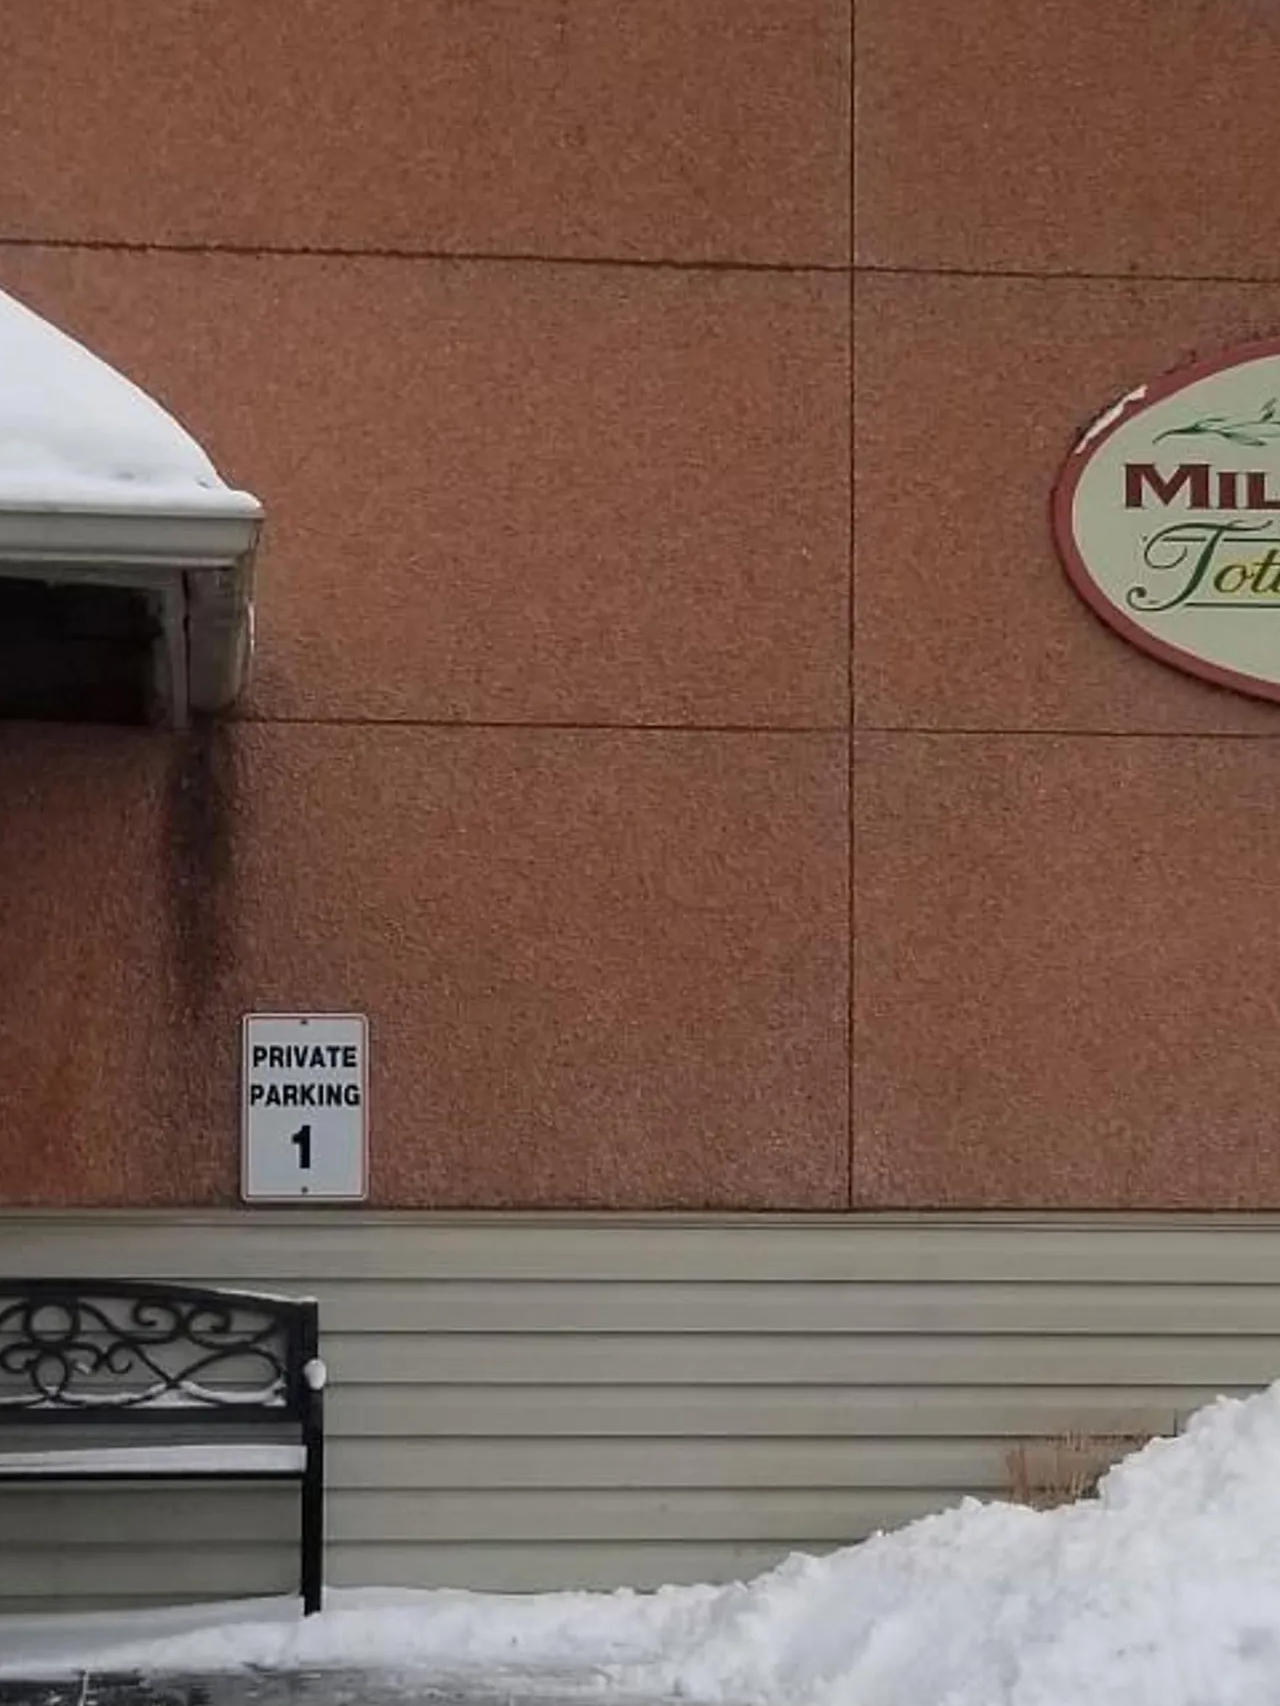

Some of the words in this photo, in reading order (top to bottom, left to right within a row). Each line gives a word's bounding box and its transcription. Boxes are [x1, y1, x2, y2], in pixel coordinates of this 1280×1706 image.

[252, 1045, 357, 1068] PRIVATE
[250, 1084, 361, 1107] PARKING
[291, 1125, 311, 1169] 1
